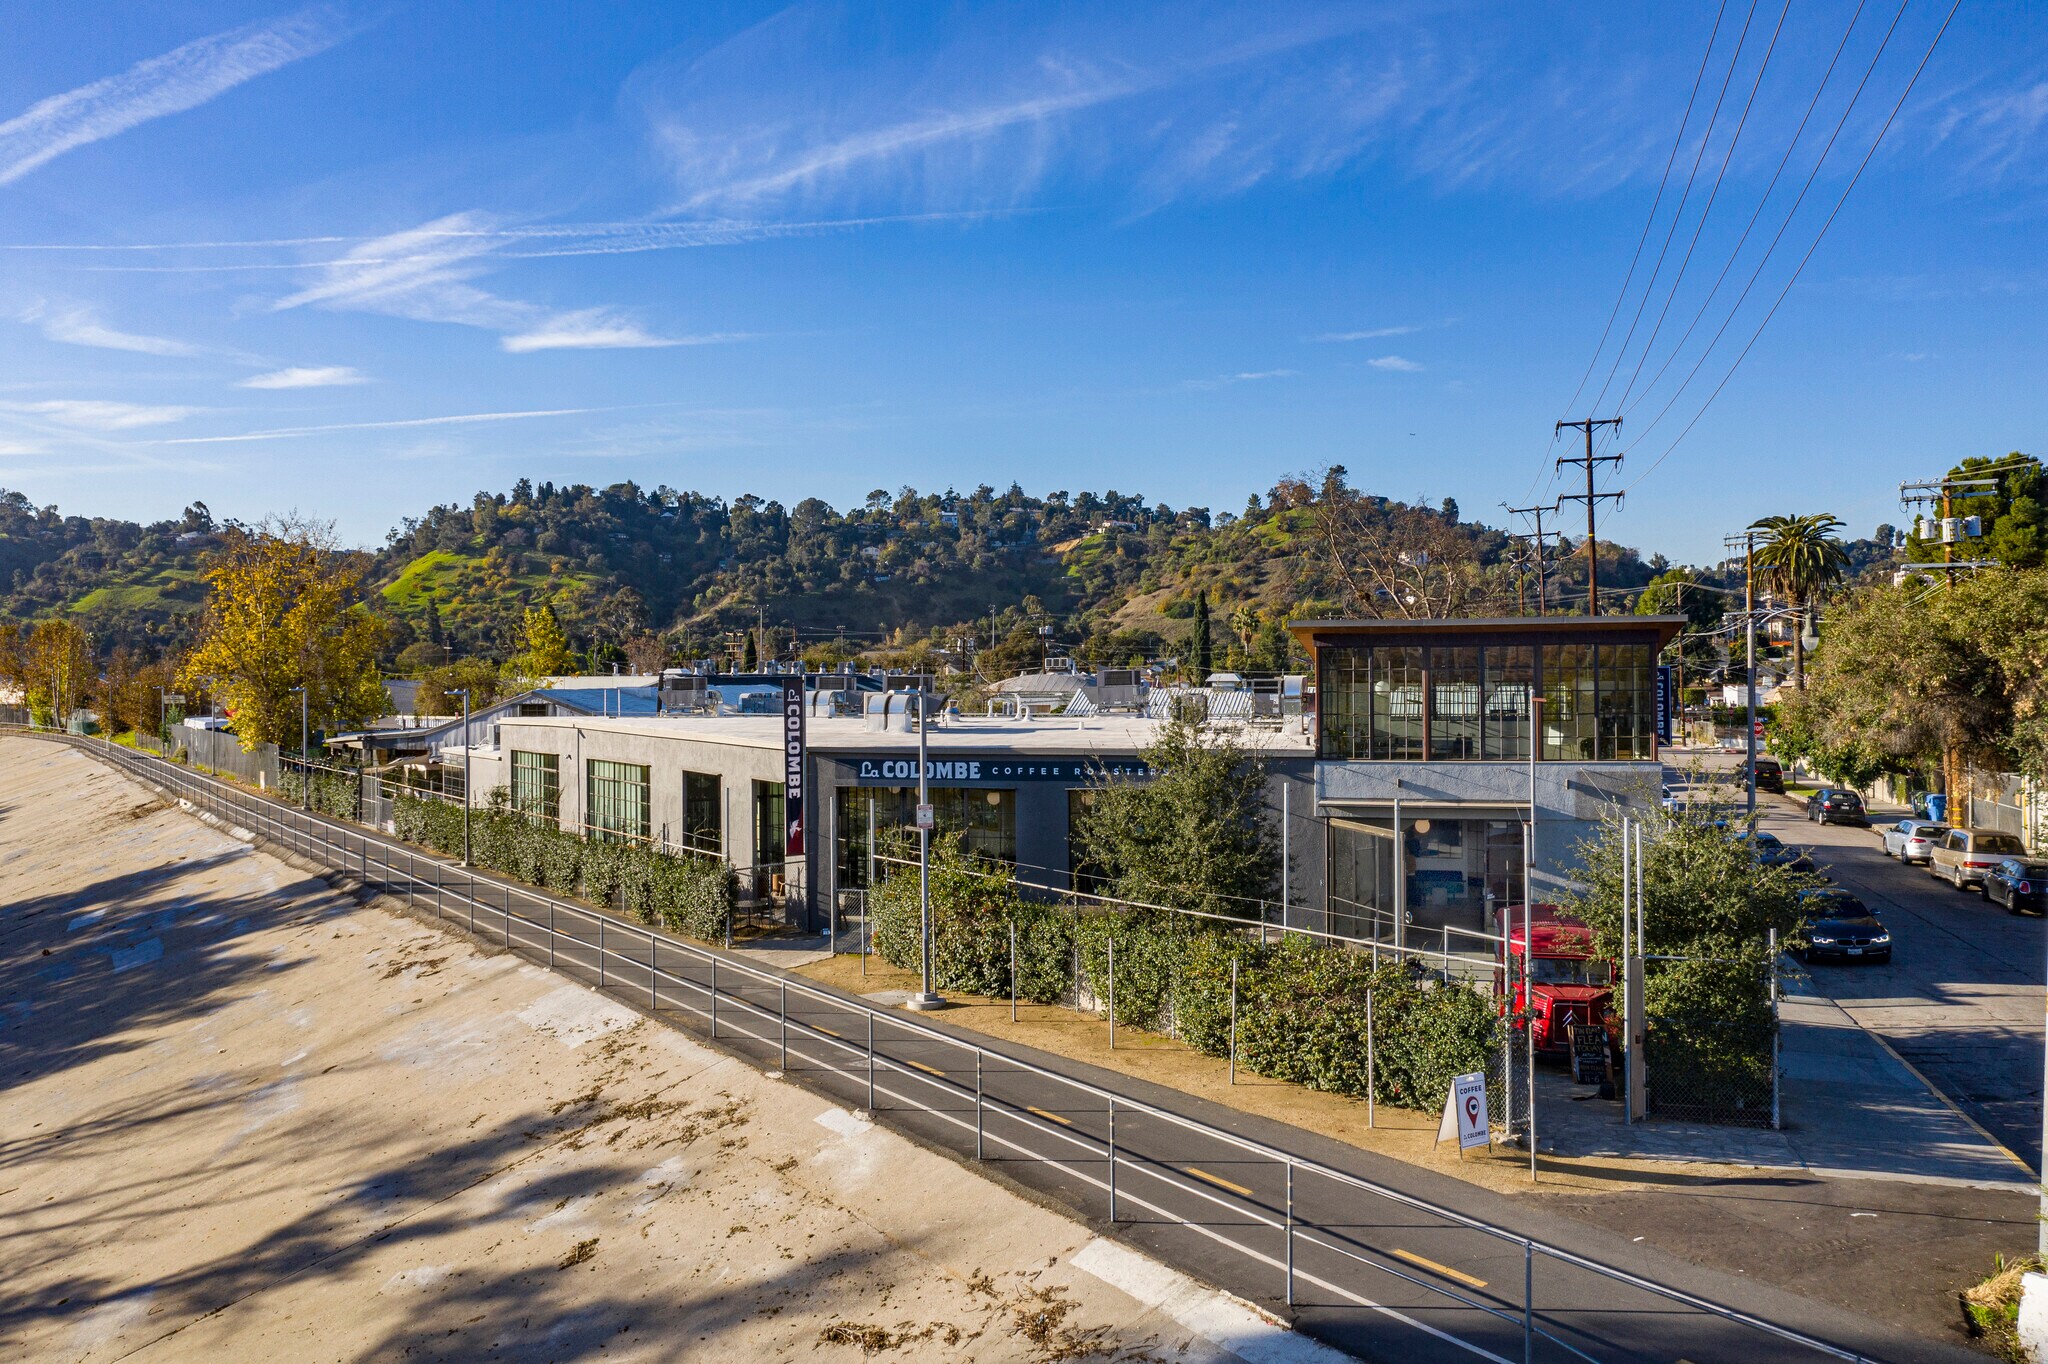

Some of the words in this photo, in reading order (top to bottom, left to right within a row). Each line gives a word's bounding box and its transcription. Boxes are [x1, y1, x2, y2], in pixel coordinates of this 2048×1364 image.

[787, 704, 801, 799] COLOMBE
[860, 761, 879, 777] La
[992, 767, 1060, 775] COFFEE
[1577, 1035, 1602, 1045] FLEA
[1575, 1044, 1603, 1053] TODAY
[1460, 1085, 1482, 1095] COFFEE
[1467, 1130, 1486, 1139] COLOMBE
